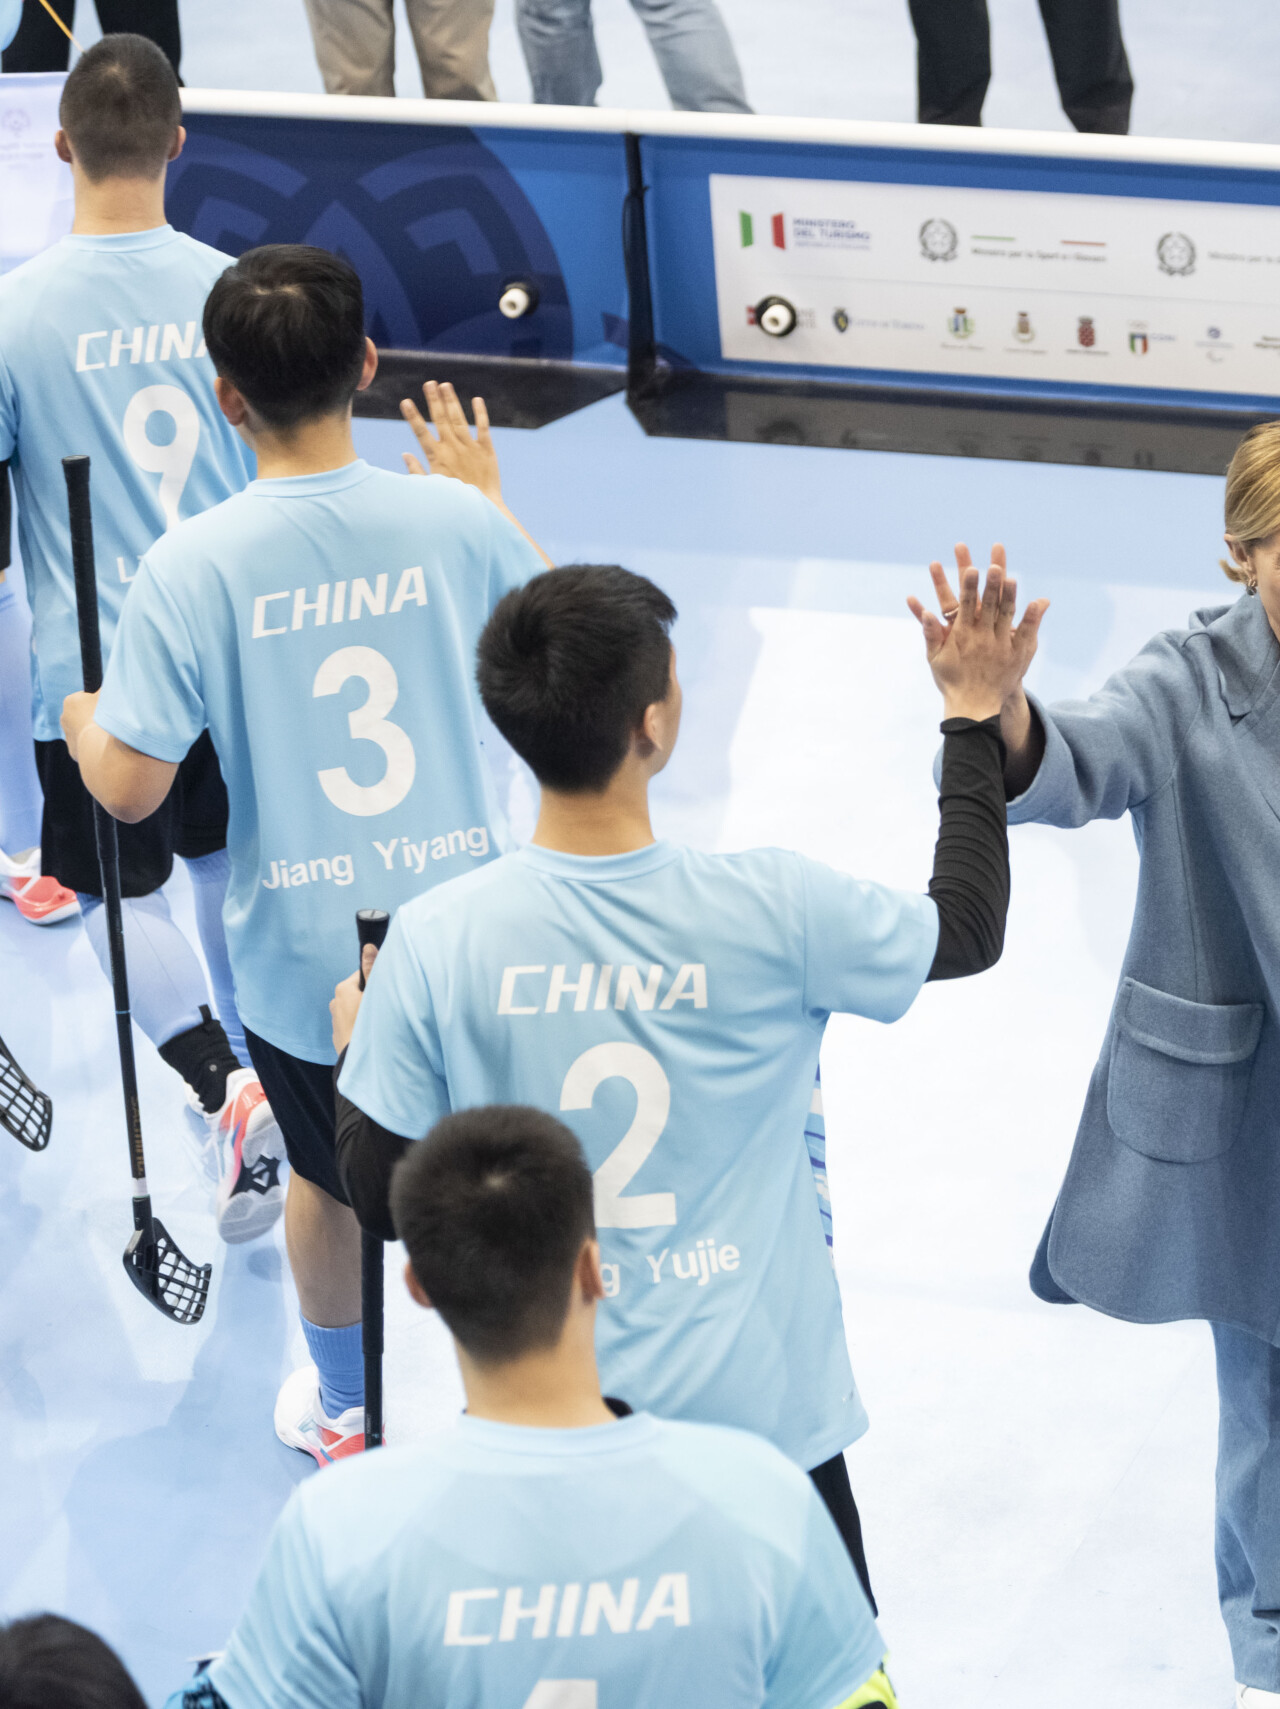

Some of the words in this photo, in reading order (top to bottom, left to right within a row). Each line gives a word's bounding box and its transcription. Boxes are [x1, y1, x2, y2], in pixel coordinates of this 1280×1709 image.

[123, 384, 200, 532] 9
[252, 566, 428, 639] CHINA
[312, 645, 416, 817] 3
[261, 853, 355, 890] Jiang
[371, 826, 490, 874] Yiyang
[497, 963, 708, 1015] CHINA
[560, 1041, 677, 1229] 2
[646, 1239, 740, 1286] Yujie
[443, 1572, 690, 1646] CHINA
